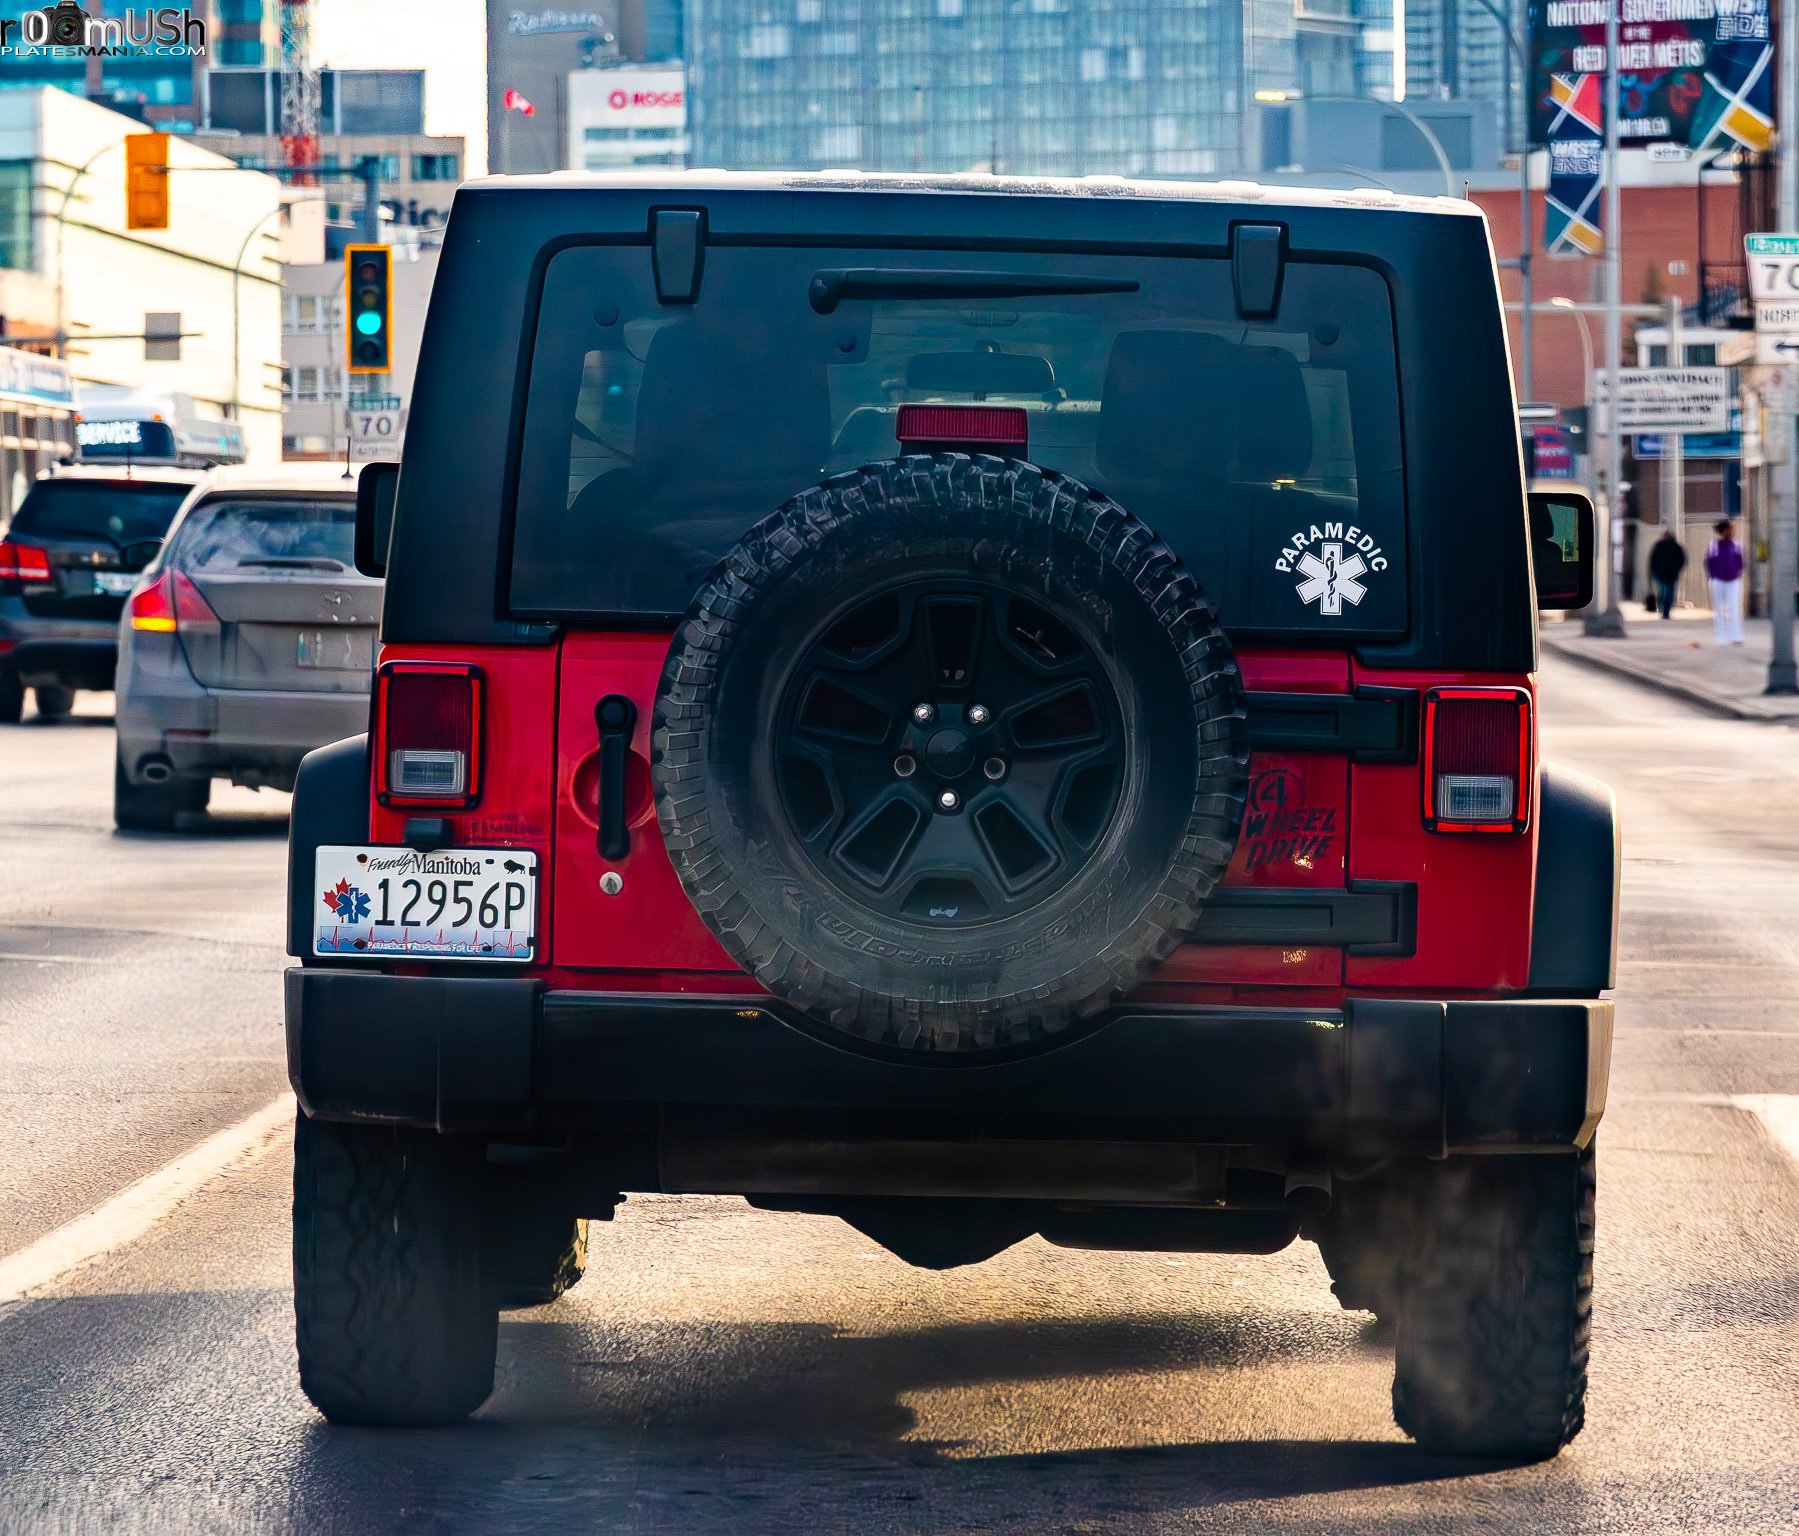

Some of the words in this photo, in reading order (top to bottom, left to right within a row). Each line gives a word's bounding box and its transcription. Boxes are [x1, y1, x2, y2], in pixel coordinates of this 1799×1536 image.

[1547, 3, 1621, 26] NATIONA
[633, 91, 682, 107] ROGE
[360, 416, 391, 435] 70
[1275, 522, 1388, 572] PARAMEDIC
[1246, 807, 1336, 838] WHEEL
[411, 853, 482, 876] Manitoba
[1246, 835, 1335, 869] DRIVE
[373, 877, 526, 930] 12956P
